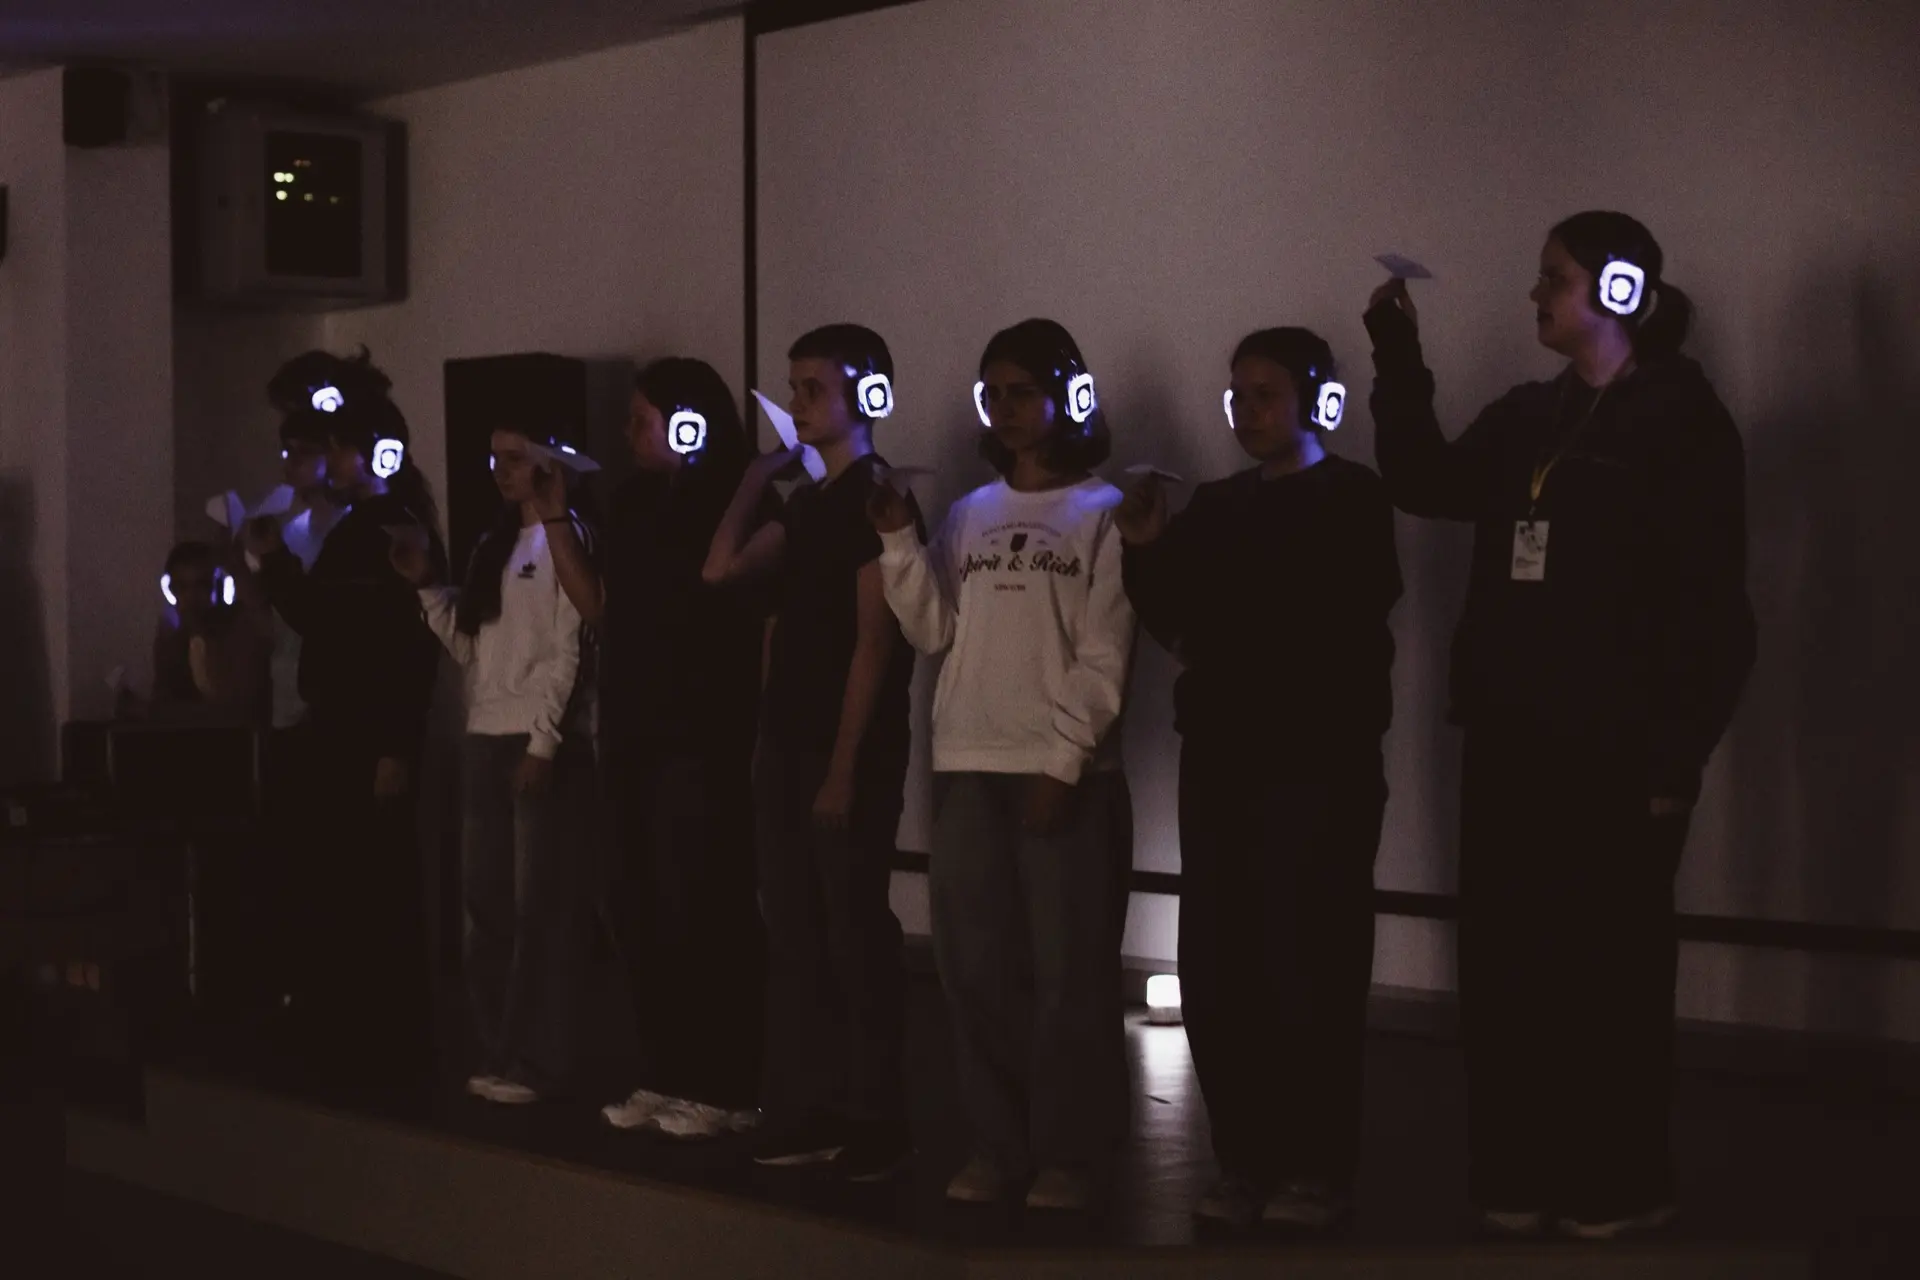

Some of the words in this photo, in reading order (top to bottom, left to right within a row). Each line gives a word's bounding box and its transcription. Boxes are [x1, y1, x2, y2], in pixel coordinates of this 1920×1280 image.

[959, 552, 1001, 582] pirit
[1007, 553, 1023, 572] &
[1029, 550, 1081, 577] Rich
